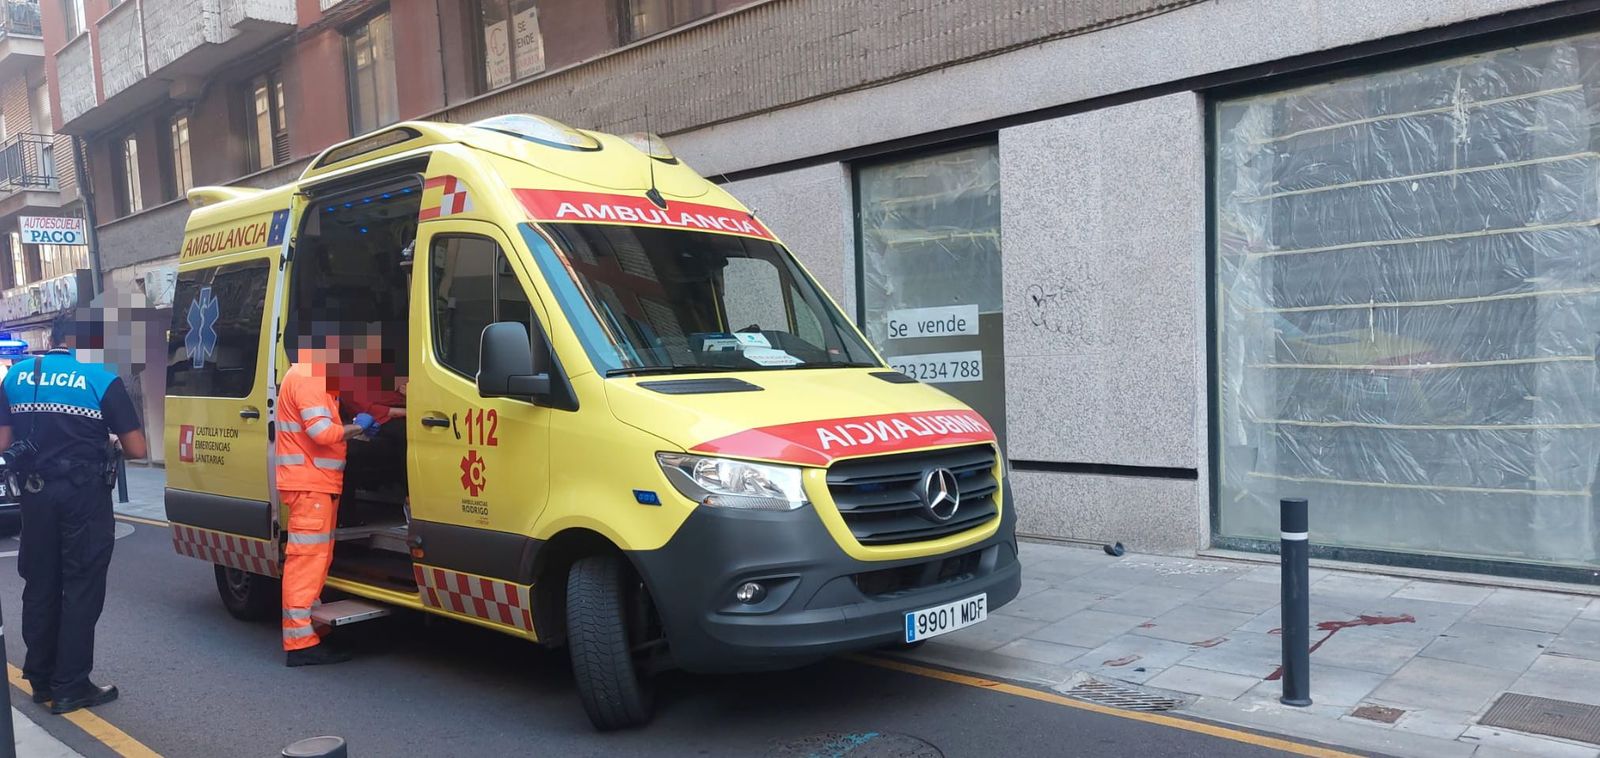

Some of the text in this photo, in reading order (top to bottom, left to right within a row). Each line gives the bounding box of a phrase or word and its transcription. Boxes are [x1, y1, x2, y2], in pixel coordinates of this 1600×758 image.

[517, 20, 527, 33] SE
[515, 33, 535, 48] ENDE
[24, 217, 81, 230] AUTOESCUELA
[556, 202, 762, 236] AMBULANCIA
[182, 221, 267, 259] AMBULANCIA
[889, 314, 966, 338] Se vende
[17, 371, 86, 389] POLICÍA
[196, 426, 219, 437] CASTILLA
[465, 407, 498, 446] 112
[195, 440, 231, 452] EMERGENCIAS
[195, 454, 225, 466] SANITARIAS
[462, 504, 489, 515] RODRIGO
[918, 598, 984, 635] 9901 MDF
